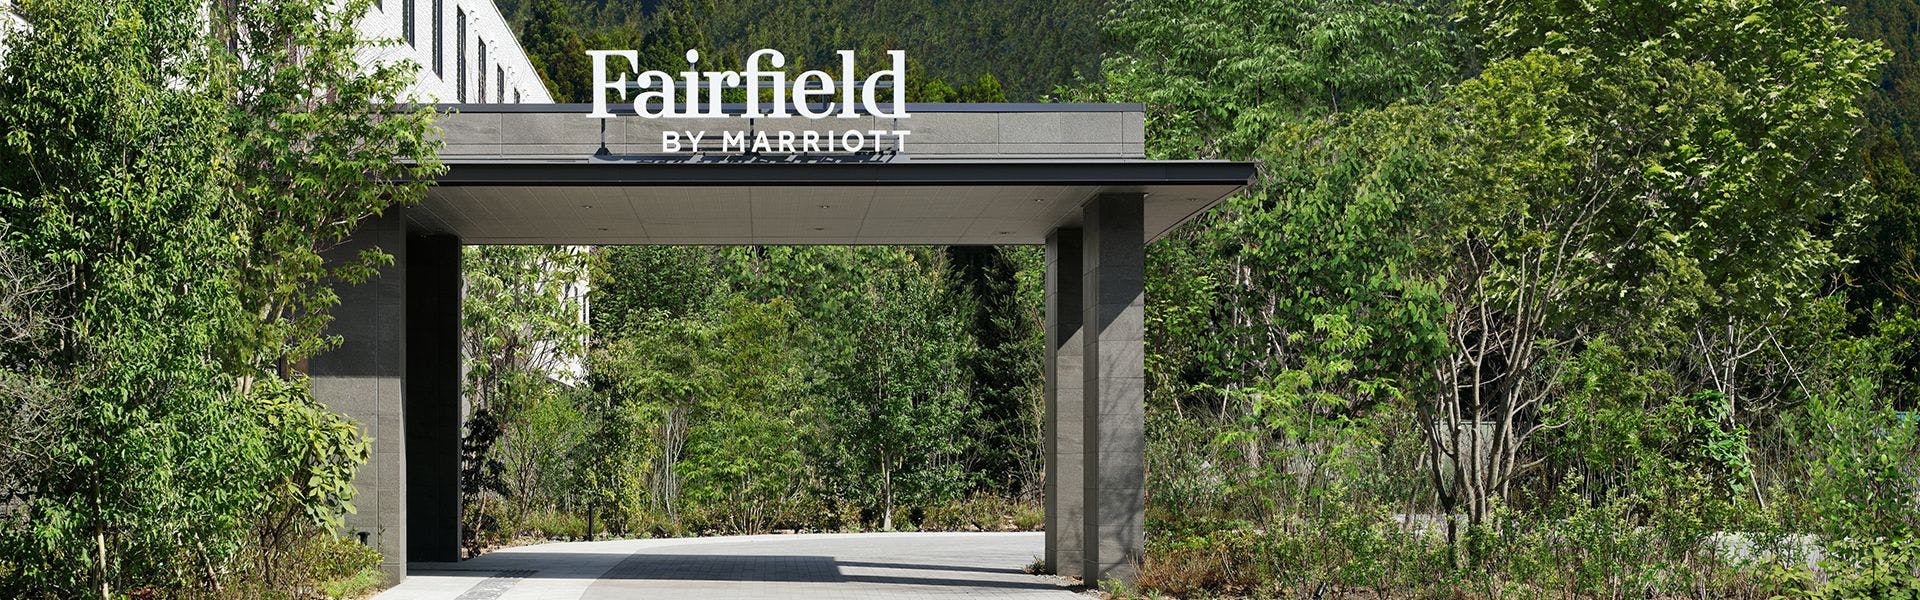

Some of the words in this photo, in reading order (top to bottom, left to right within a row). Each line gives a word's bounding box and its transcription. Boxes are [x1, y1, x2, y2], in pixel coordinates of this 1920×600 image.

[585, 49, 912, 119] Fairfield
[662, 130, 706, 153] BY
[722, 130, 911, 153] MARRIOTT
